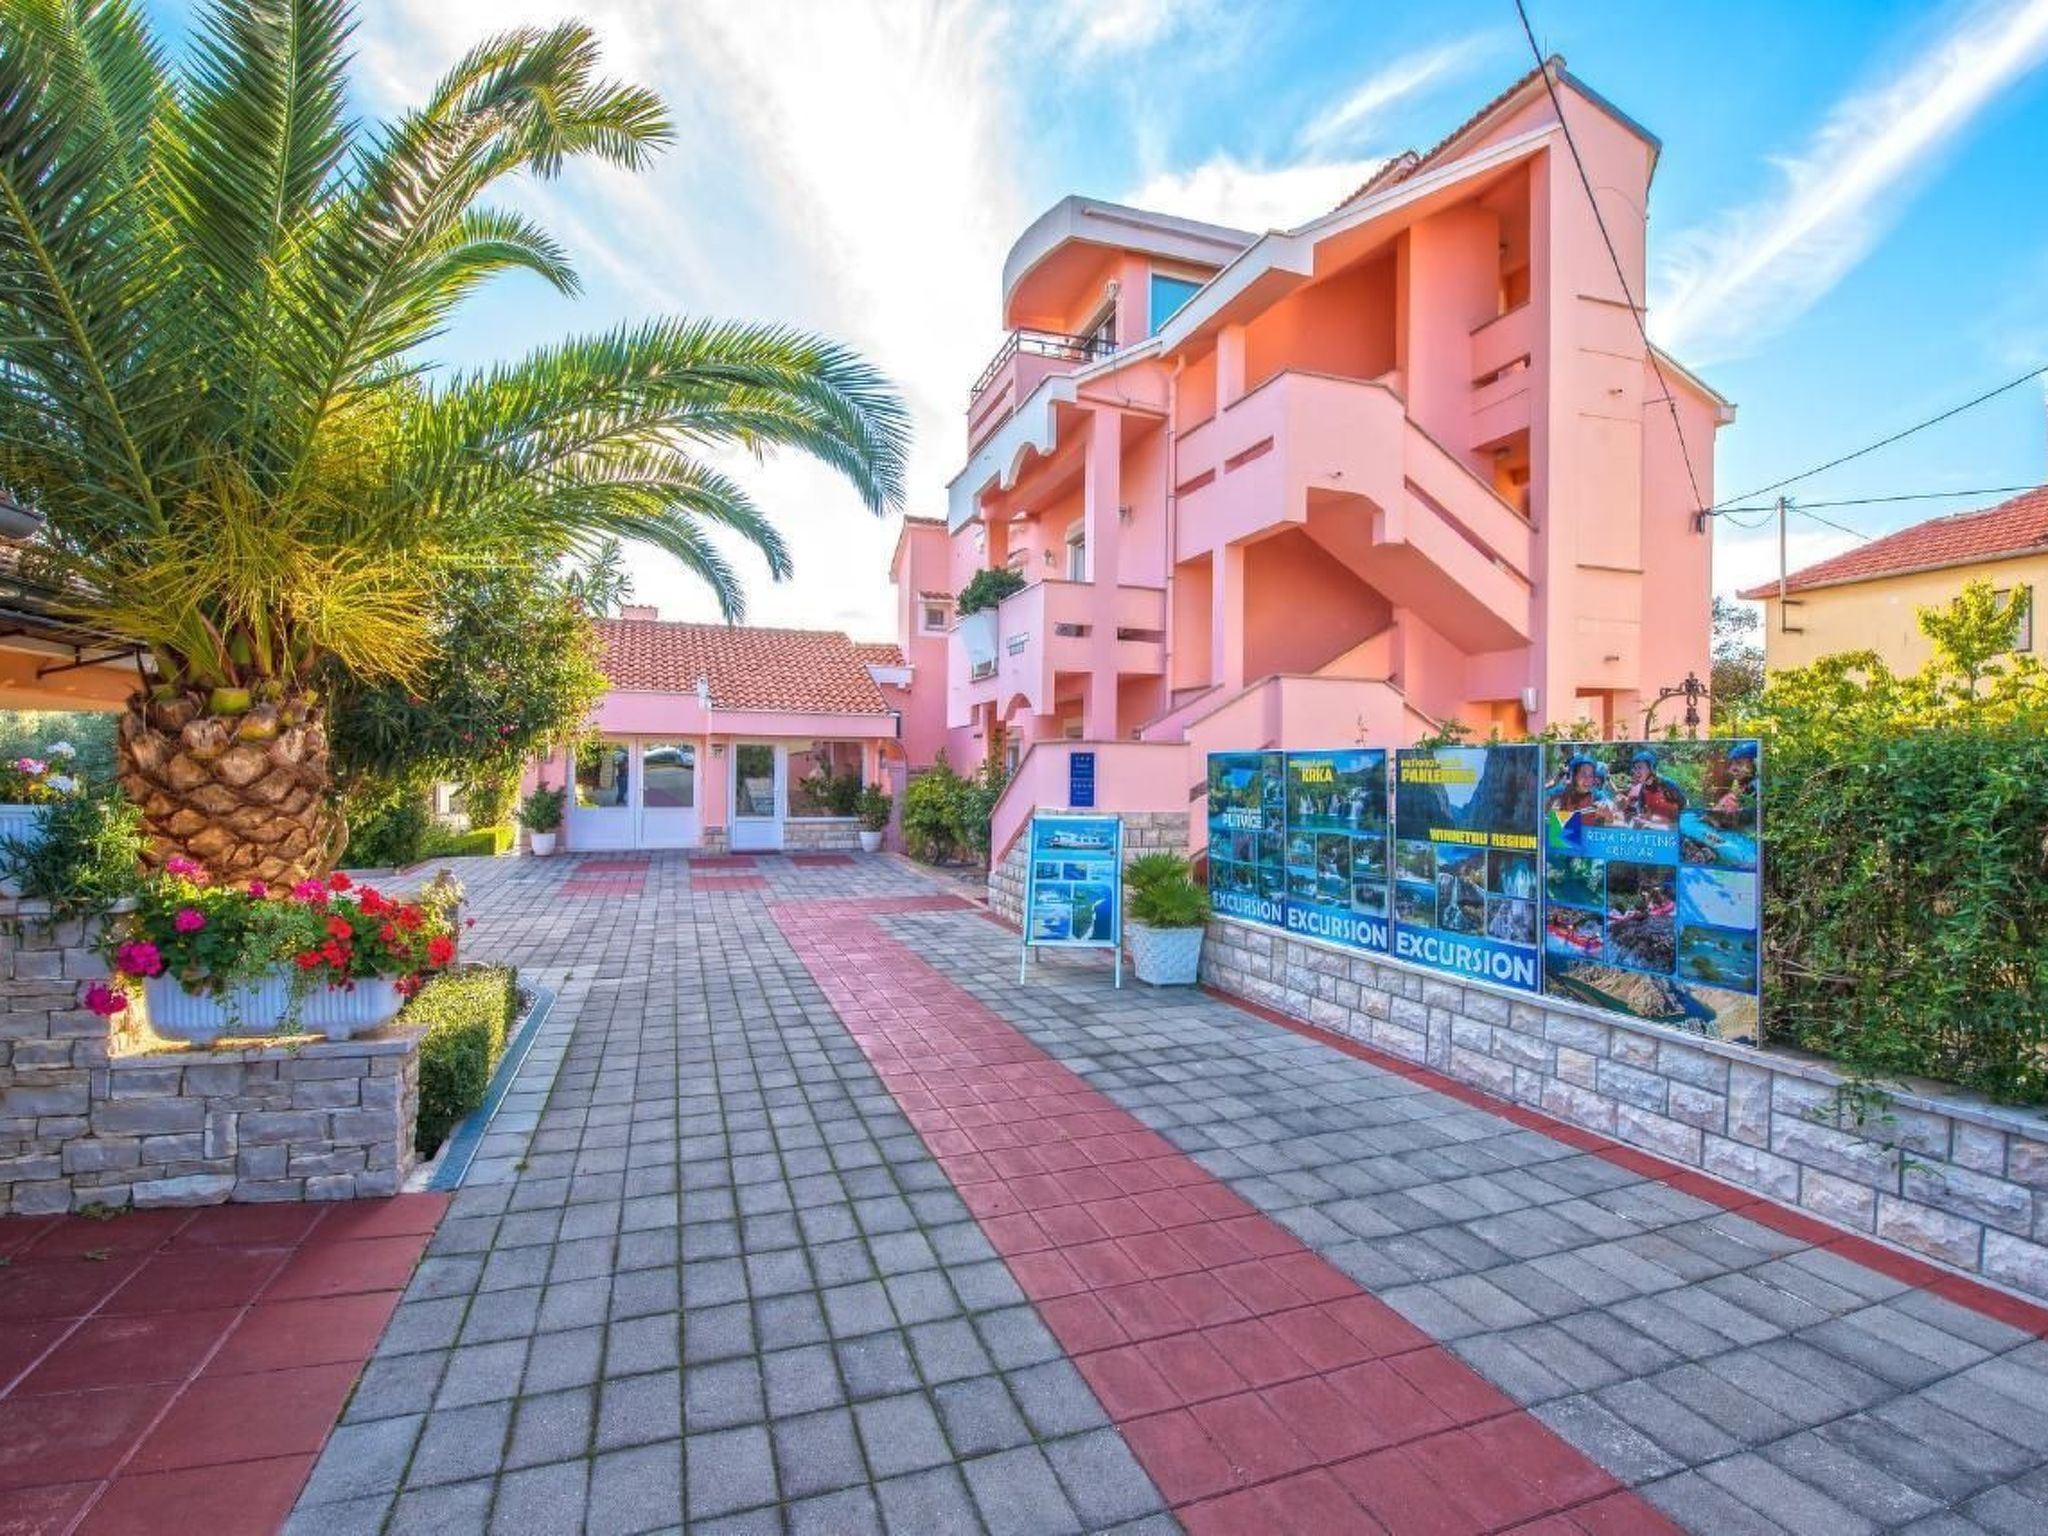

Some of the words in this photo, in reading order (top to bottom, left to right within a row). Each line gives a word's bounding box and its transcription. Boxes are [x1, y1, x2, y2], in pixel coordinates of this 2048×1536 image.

[1302, 768, 1333, 782] KRKA
[1491, 832, 1537, 849] REGION
[1212, 889, 1282, 922] EXCURSION
[1288, 907, 1387, 949] EXCURSION
[1396, 931, 1535, 985] EXCURSION
